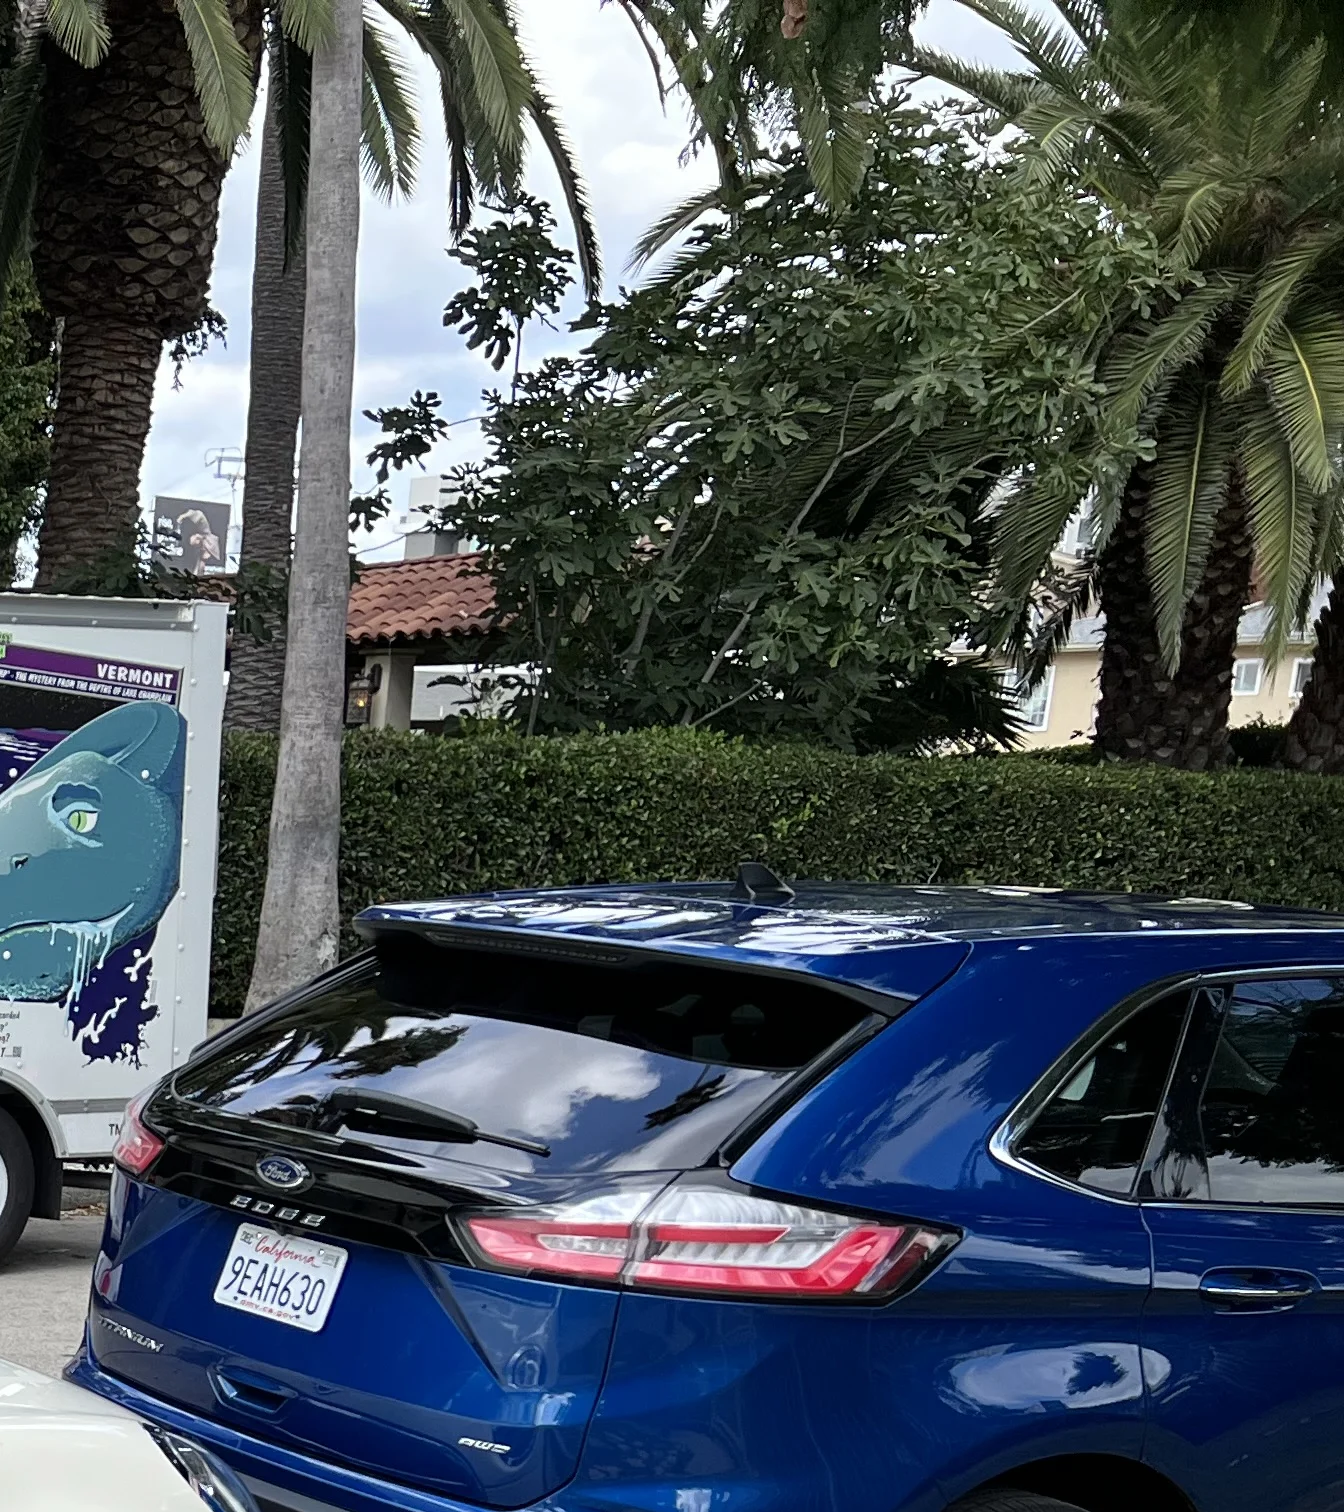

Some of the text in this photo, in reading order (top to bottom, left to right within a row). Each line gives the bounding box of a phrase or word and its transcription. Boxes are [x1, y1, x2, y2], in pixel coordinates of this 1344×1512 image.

[97, 663, 174, 688] VERMONT
[263, 1161, 292, 1182] Ford
[229, 1194, 326, 1228] EDGE
[254, 1236, 321, 1269] California
[223, 1255, 326, 1315] 9EAH630
[97, 1315, 164, 1353] TITANIUM
[457, 1437, 511, 1454] AWD
